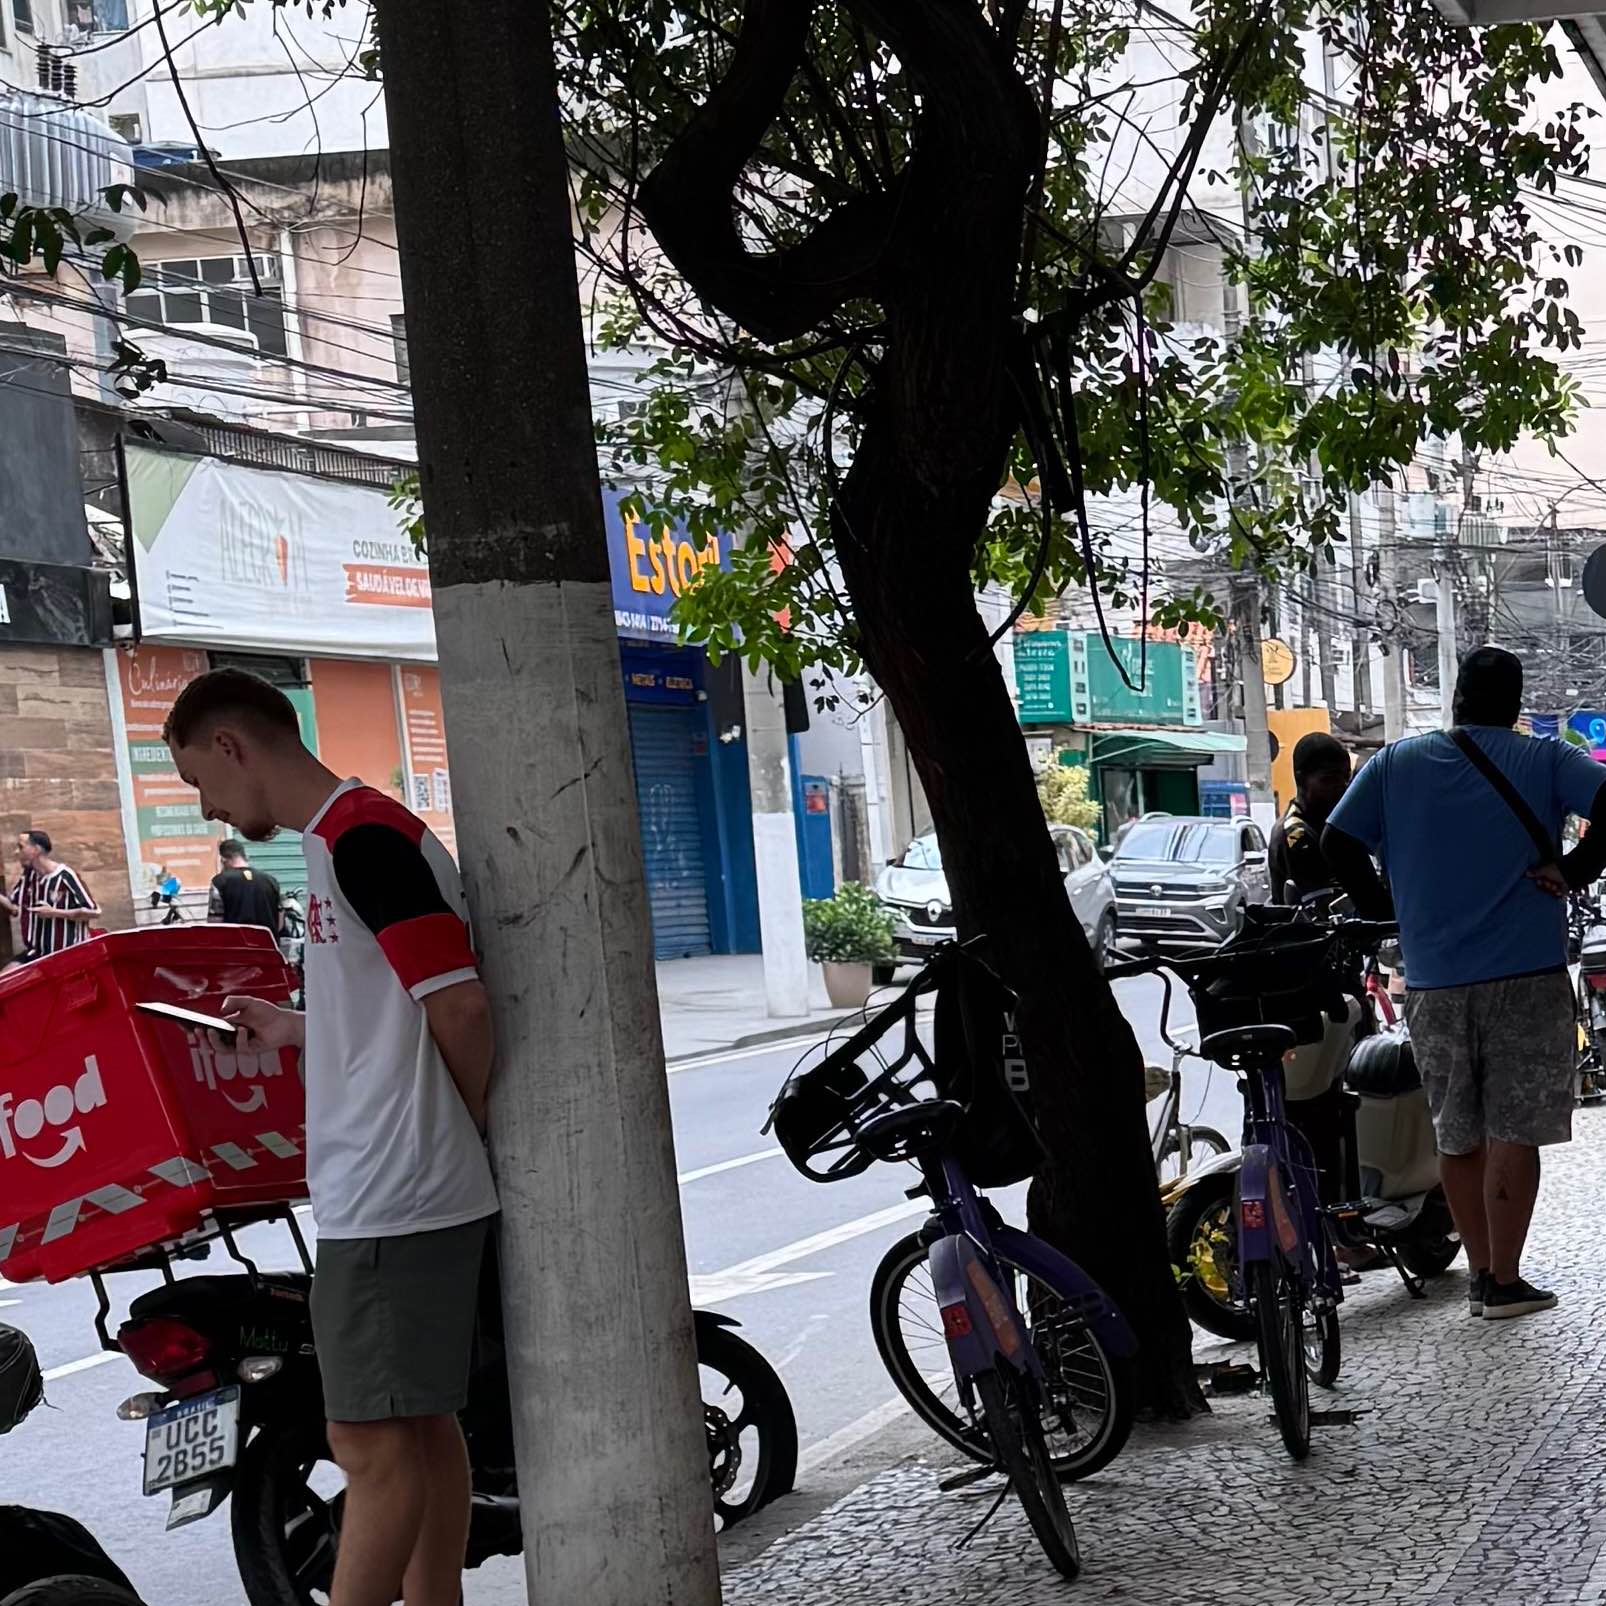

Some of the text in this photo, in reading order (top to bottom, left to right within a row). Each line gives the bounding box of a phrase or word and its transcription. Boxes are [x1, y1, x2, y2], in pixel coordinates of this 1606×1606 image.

[352, 539, 400, 562] COZINHA
[624, 504, 721, 599] Esto
[166, 1408, 219, 1451] UCC
[156, 1435, 226, 1482] 2B55
